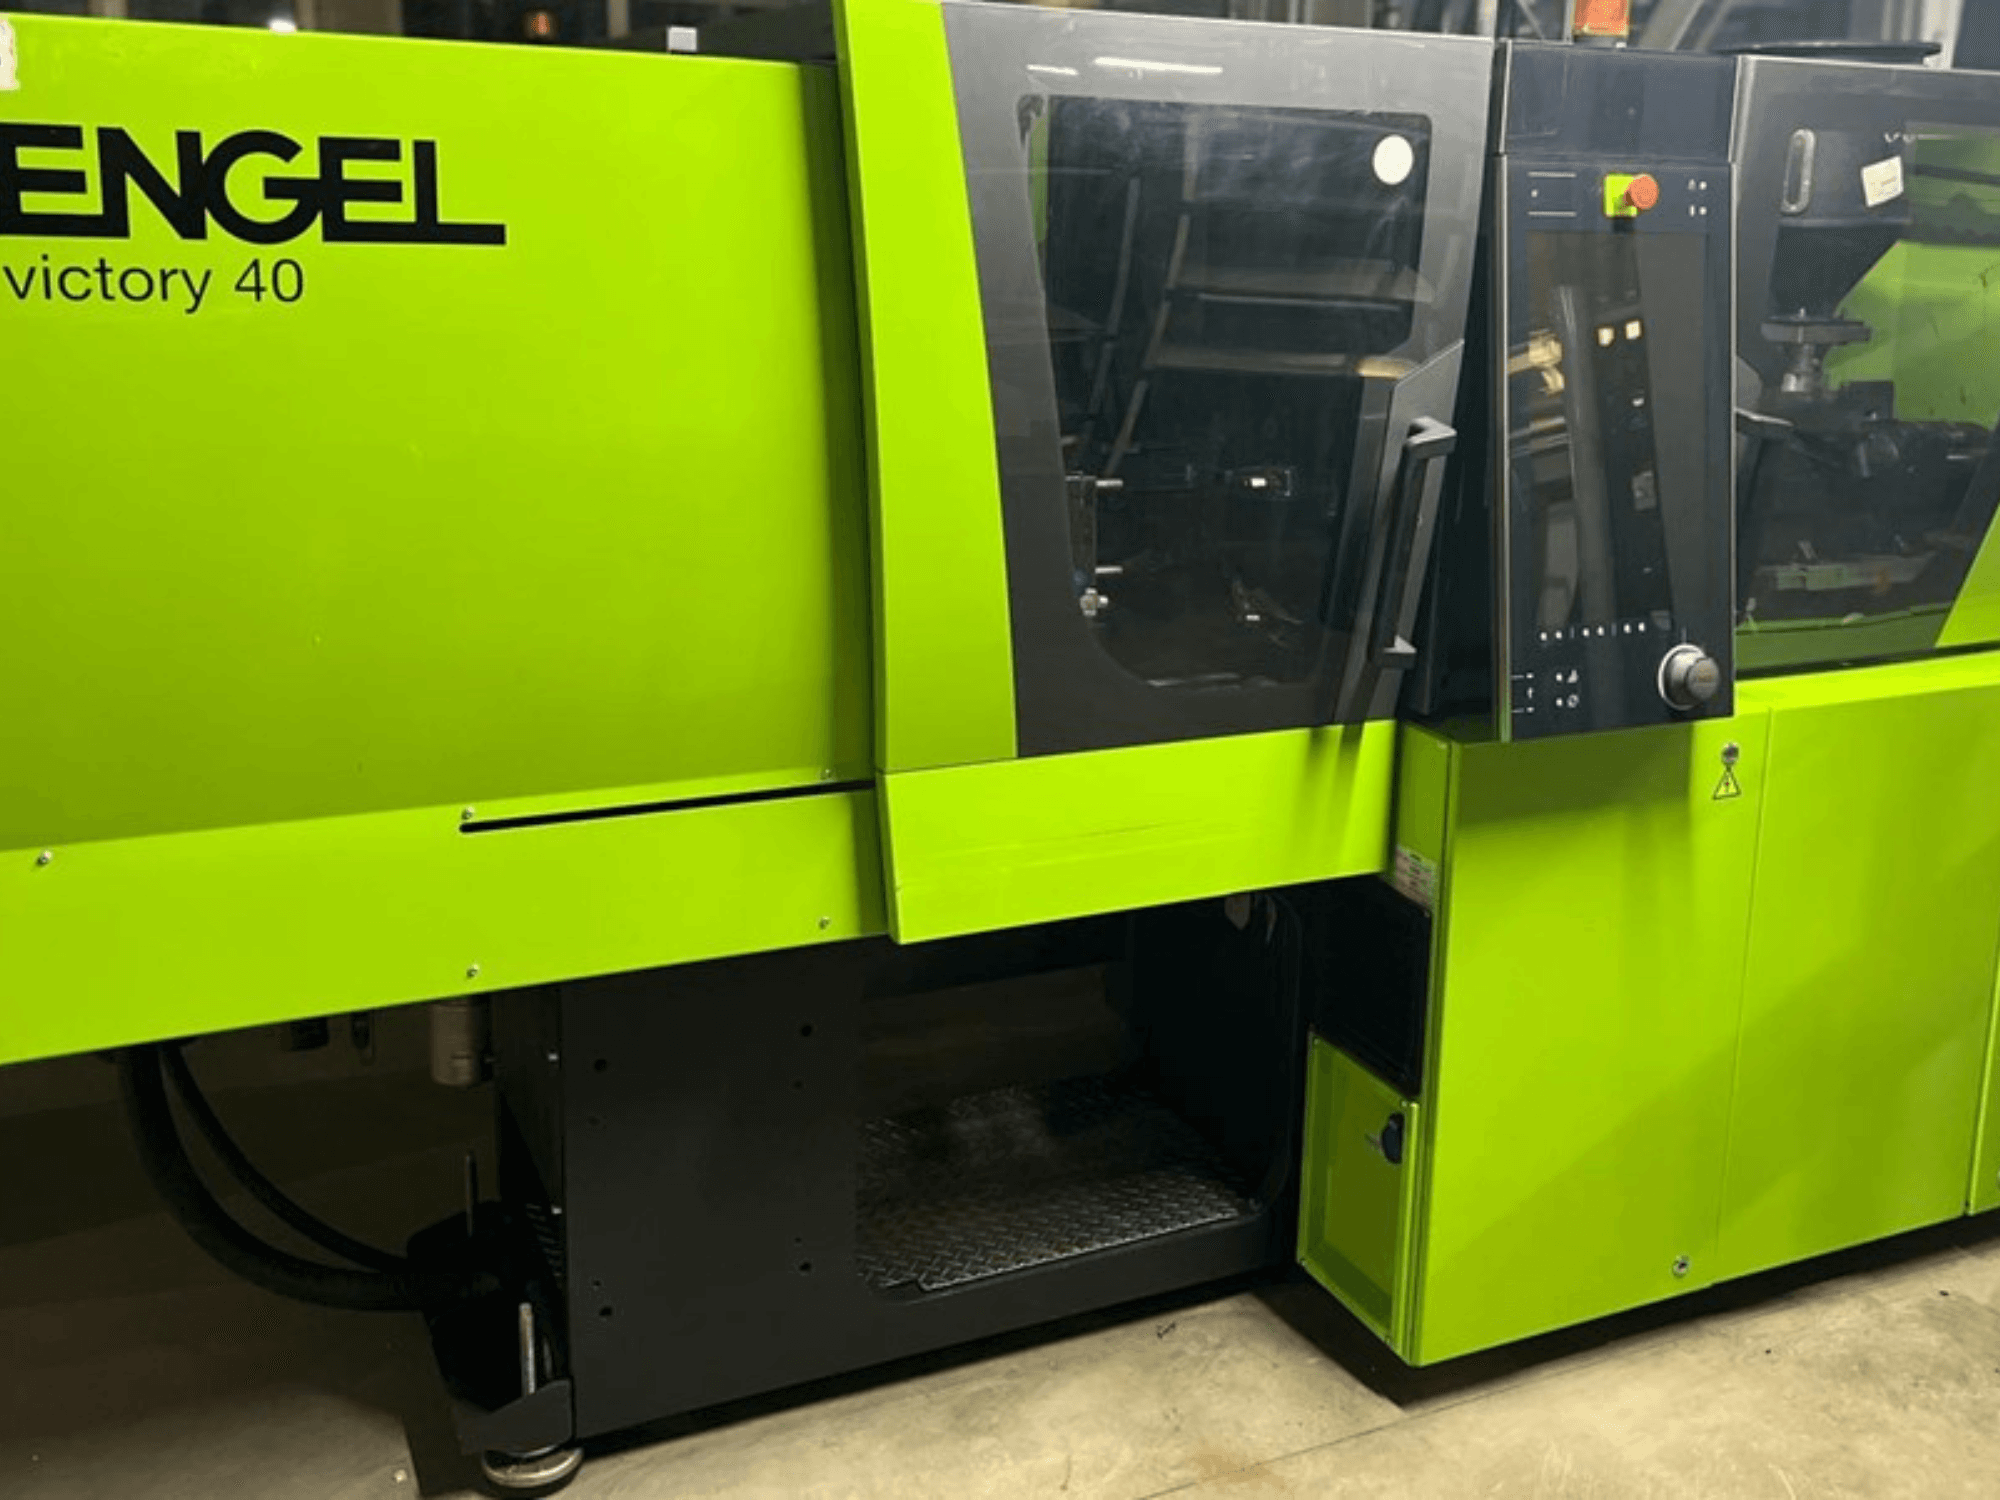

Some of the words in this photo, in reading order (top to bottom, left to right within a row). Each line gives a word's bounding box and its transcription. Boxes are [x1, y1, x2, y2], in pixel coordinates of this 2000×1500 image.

[0, 122, 506, 245] ENGEL
[3, 254, 211, 314] victory
[234, 258, 304, 303] 40
